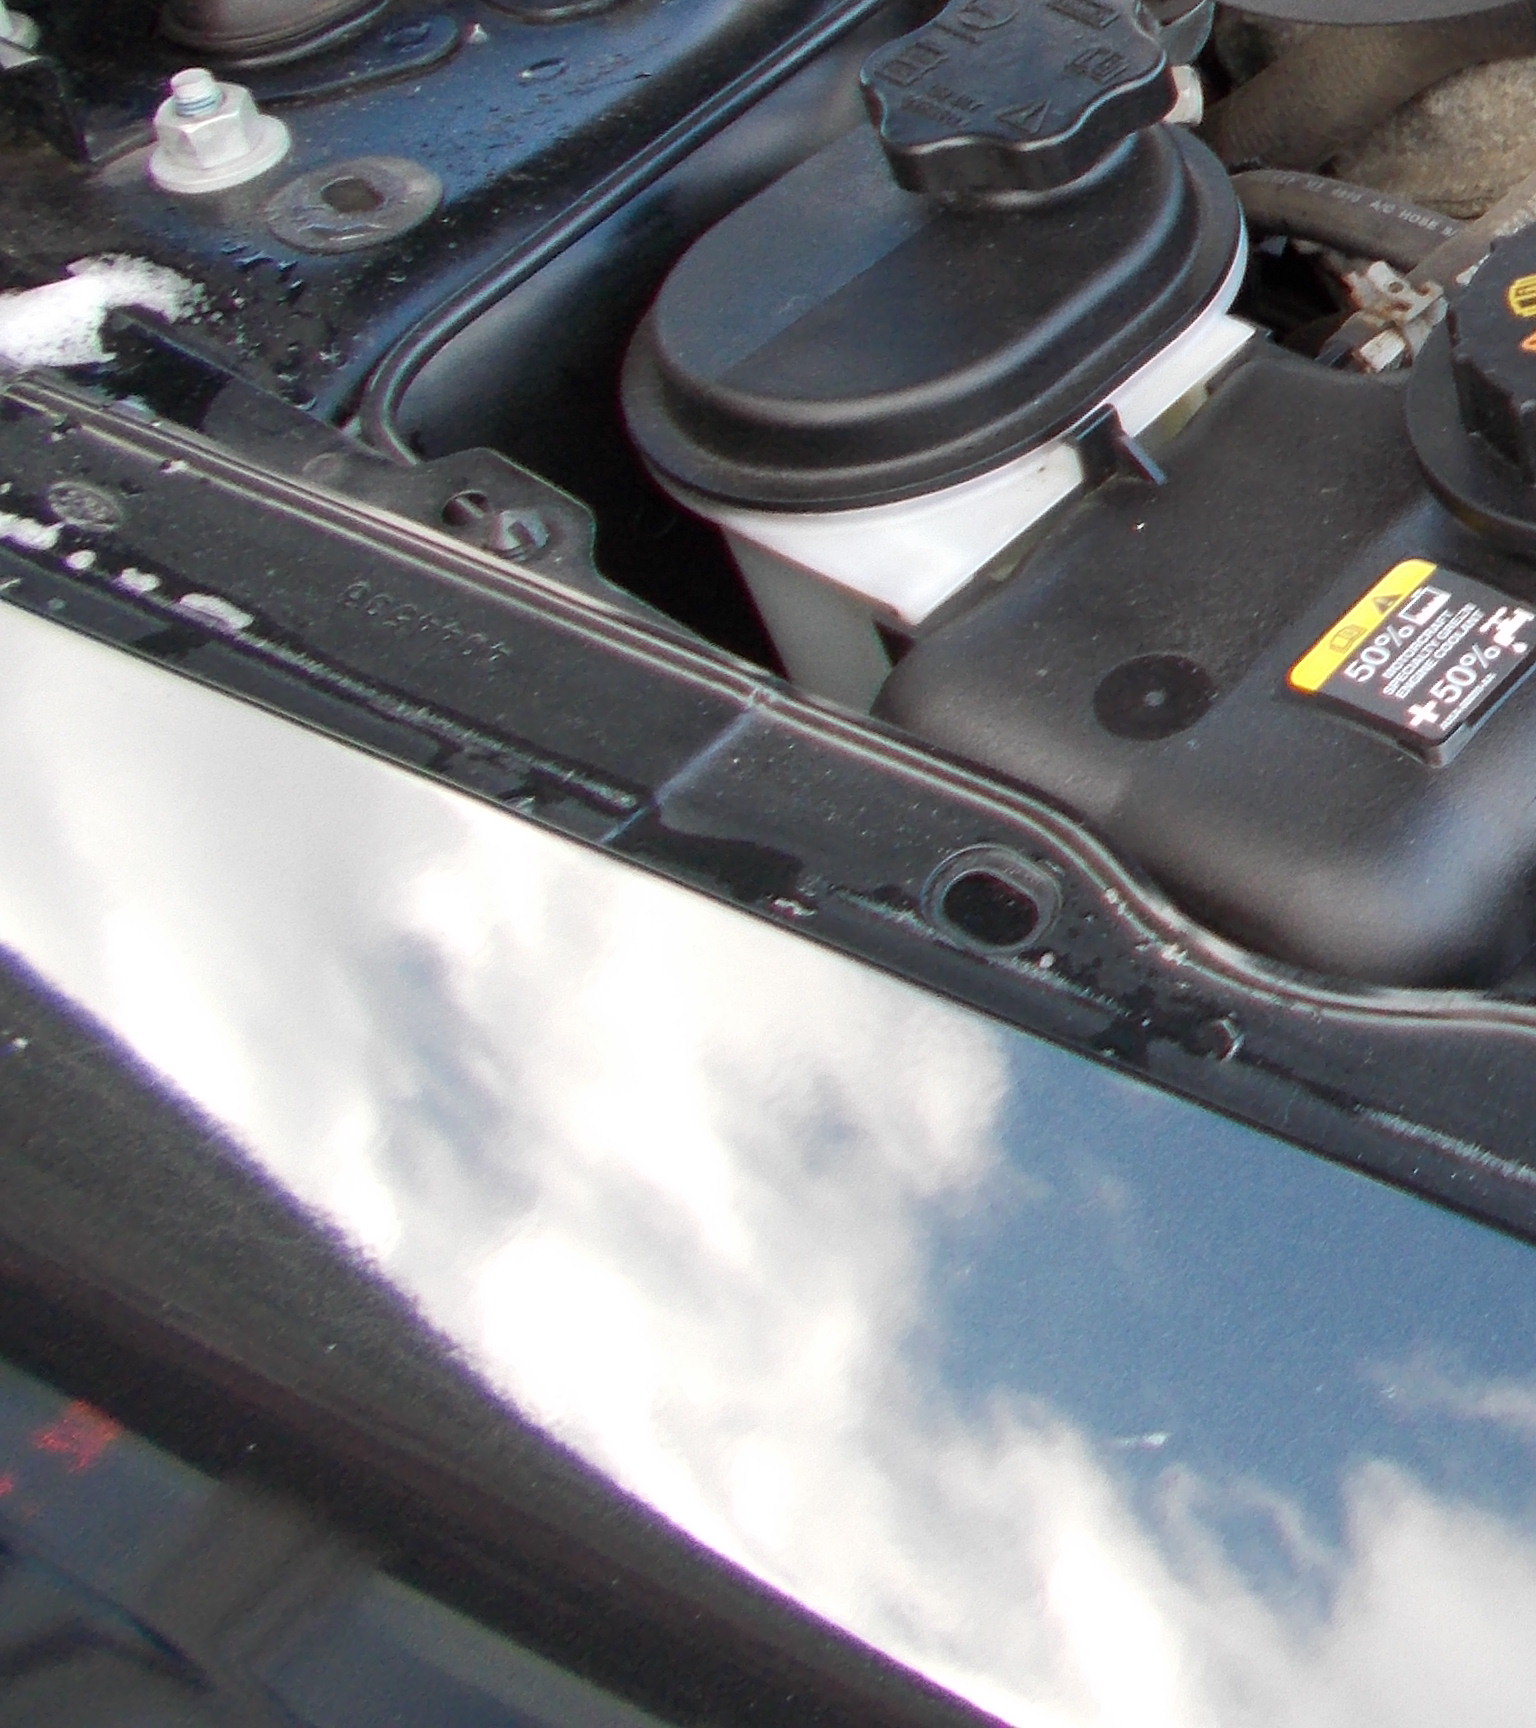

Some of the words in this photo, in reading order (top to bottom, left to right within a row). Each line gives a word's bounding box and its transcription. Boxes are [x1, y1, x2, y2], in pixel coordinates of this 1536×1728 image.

[1344, 624, 1415, 682] 50%
[1382, 609, 1454, 679] MOTORCRAFT
[1383, 641, 1439, 696] SPECIALTY
[1396, 658, 1440, 699] ENGINE
[1434, 608, 1486, 660] COOLANT
